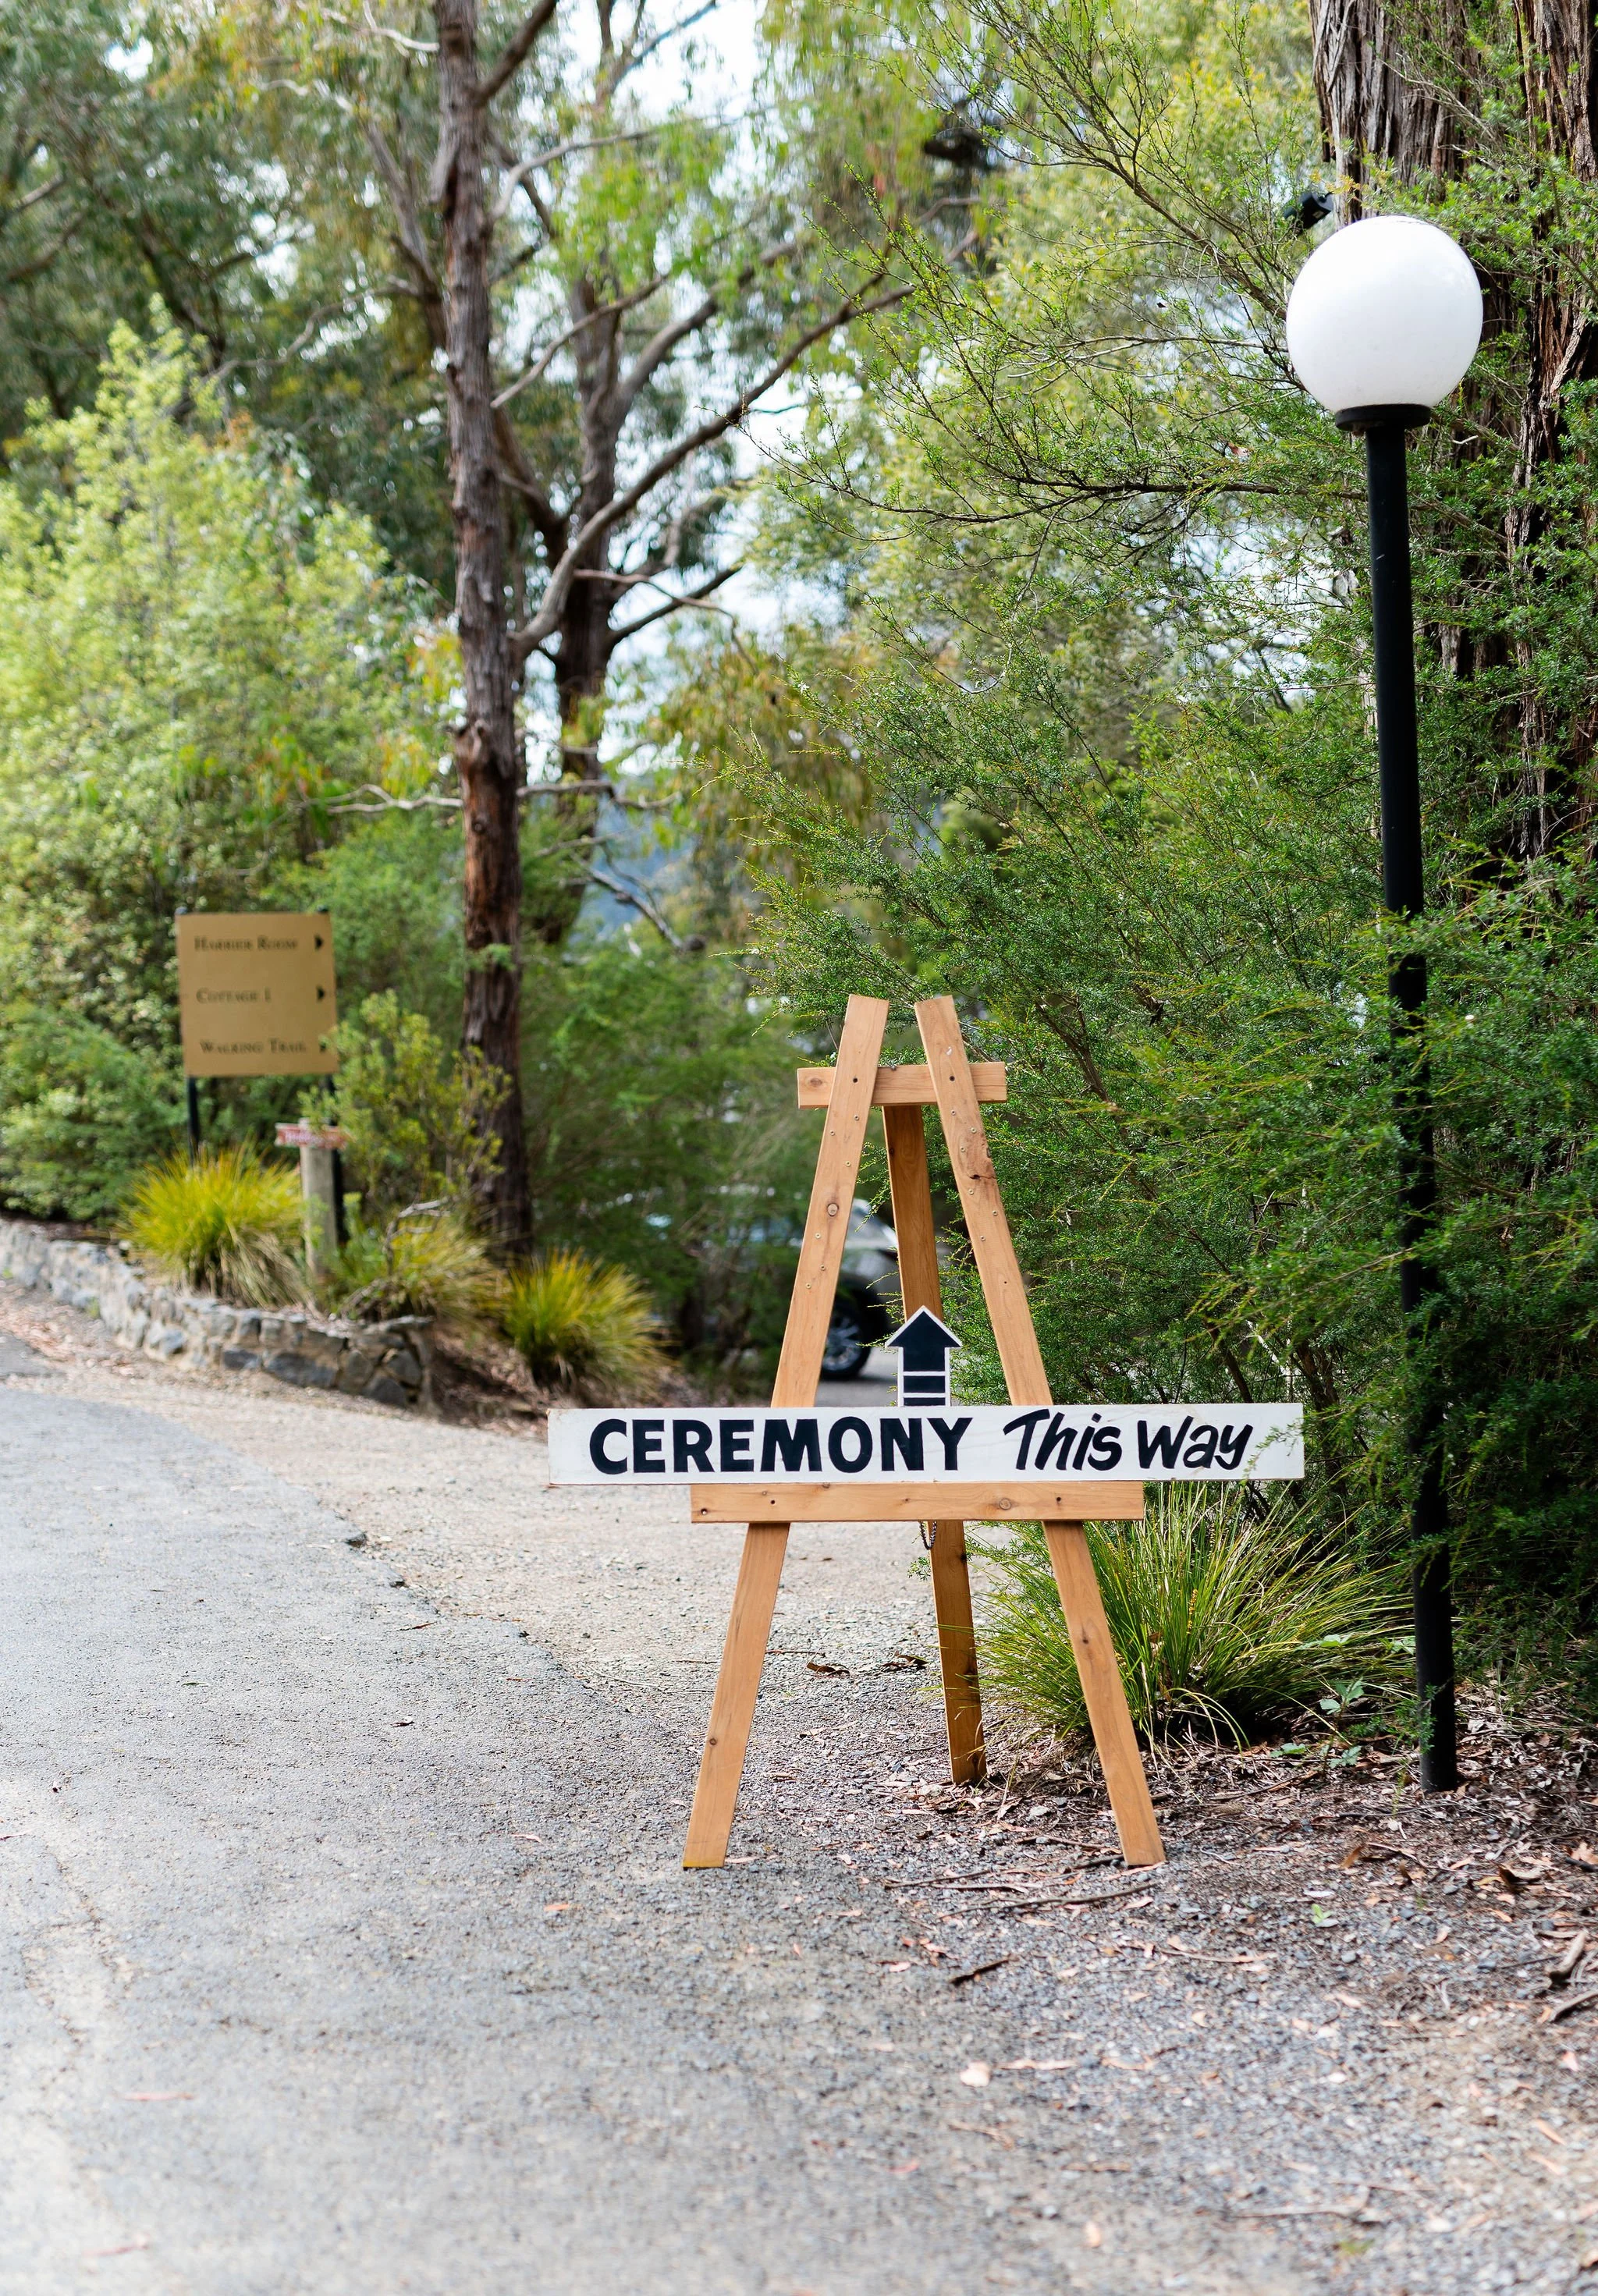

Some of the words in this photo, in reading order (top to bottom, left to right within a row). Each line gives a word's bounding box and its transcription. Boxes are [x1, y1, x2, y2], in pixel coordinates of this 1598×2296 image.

[257, 935, 298, 950] ROOM
[200, 1039, 264, 1055] WALKING
[269, 1038, 307, 1053] TRAIL
[589, 1416, 972, 1475] CEREMONY
[1003, 1408, 1123, 1471] This
[1137, 1415, 1254, 1471] Way
